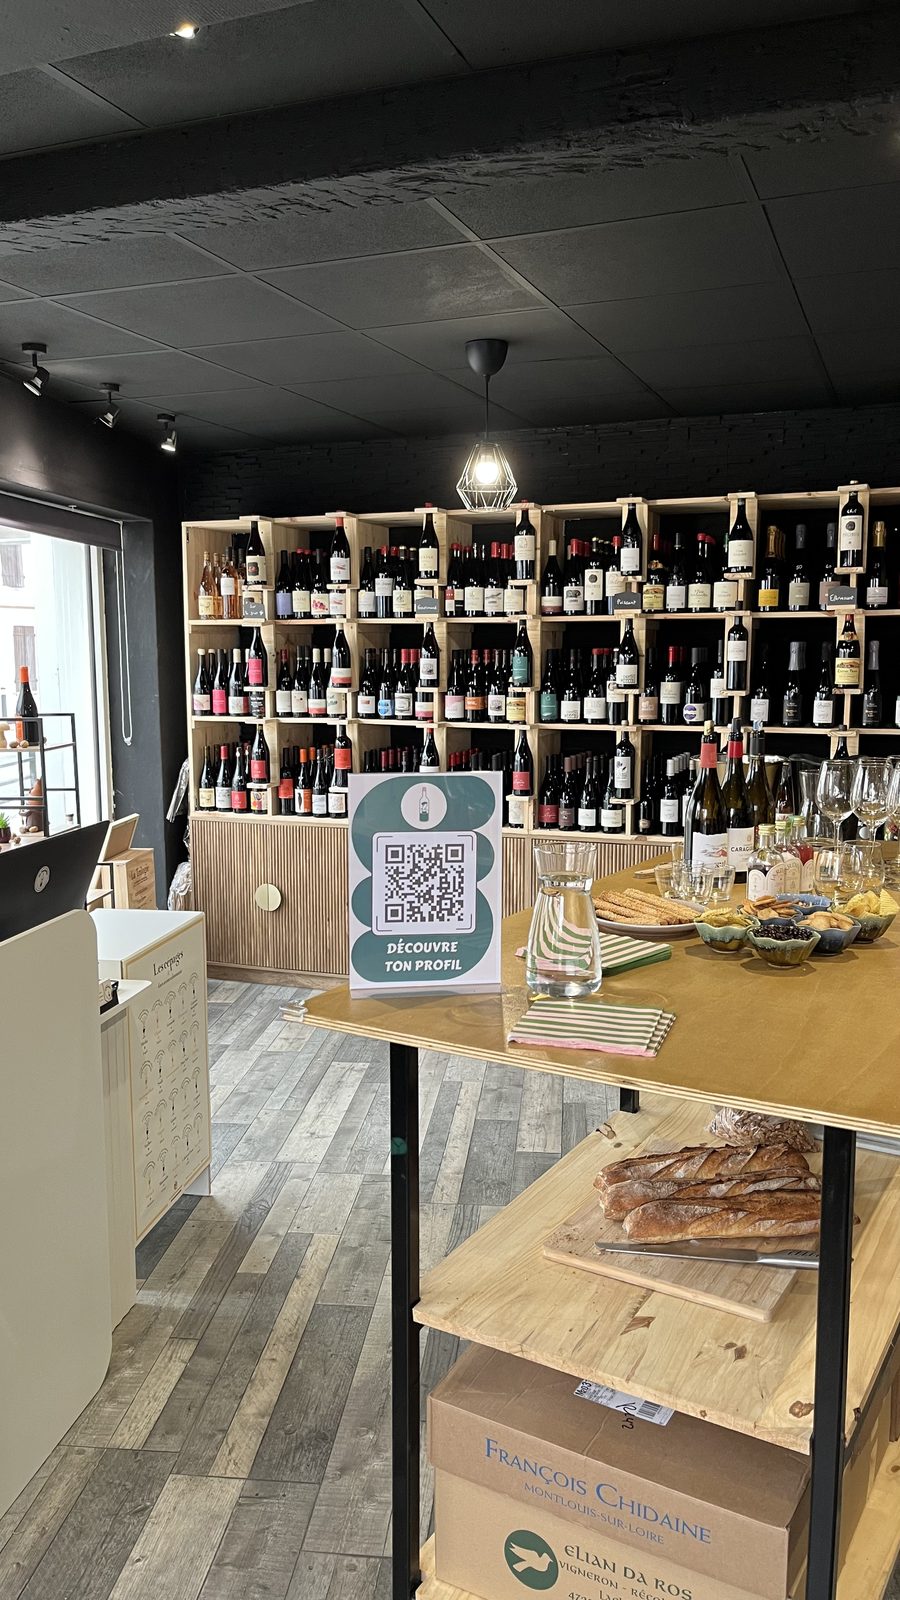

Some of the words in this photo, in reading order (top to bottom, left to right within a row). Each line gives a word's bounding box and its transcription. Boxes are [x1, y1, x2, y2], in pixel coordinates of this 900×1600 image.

[387, 938, 458, 954] DÉCOUVRE
[385, 960, 412, 972] TON
[415, 959, 462, 971] PROFIL
[524, 1482, 665, 1544] MONTLOUIS-SUR-LOIRE
[558, 1560, 618, 1590] VIGNERON
[654, 1577, 692, 1600] ROS
